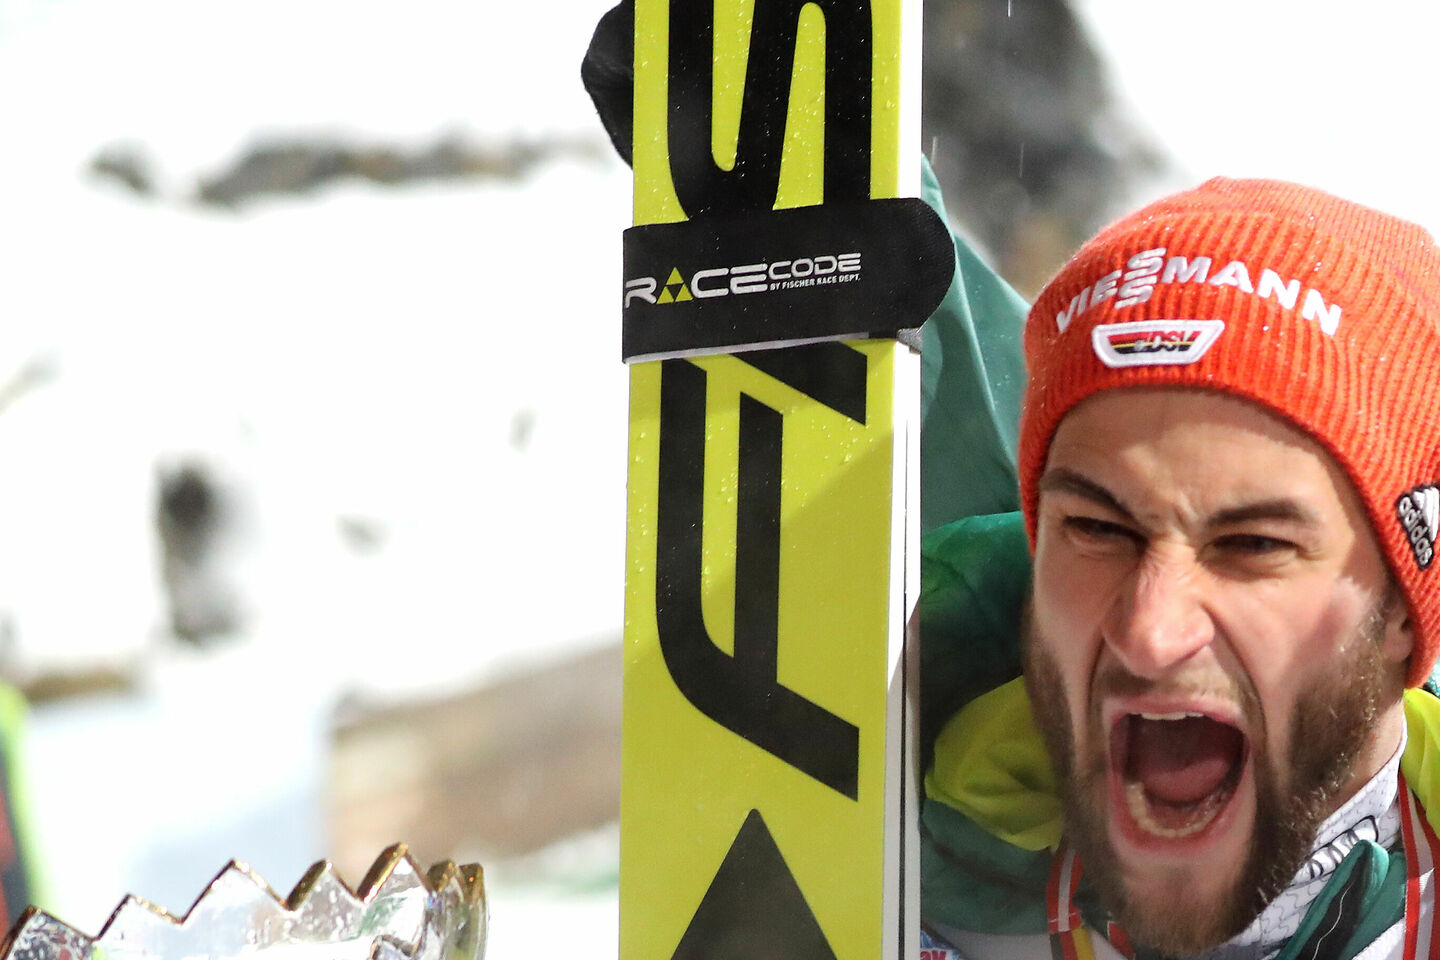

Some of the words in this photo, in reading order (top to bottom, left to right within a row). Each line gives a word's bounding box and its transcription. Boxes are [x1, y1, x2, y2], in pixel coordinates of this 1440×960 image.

[817, 276, 838, 286] RACE
[1056, 247, 1342, 336] VIESSMANN
[1398, 496, 1433, 565] adidas
